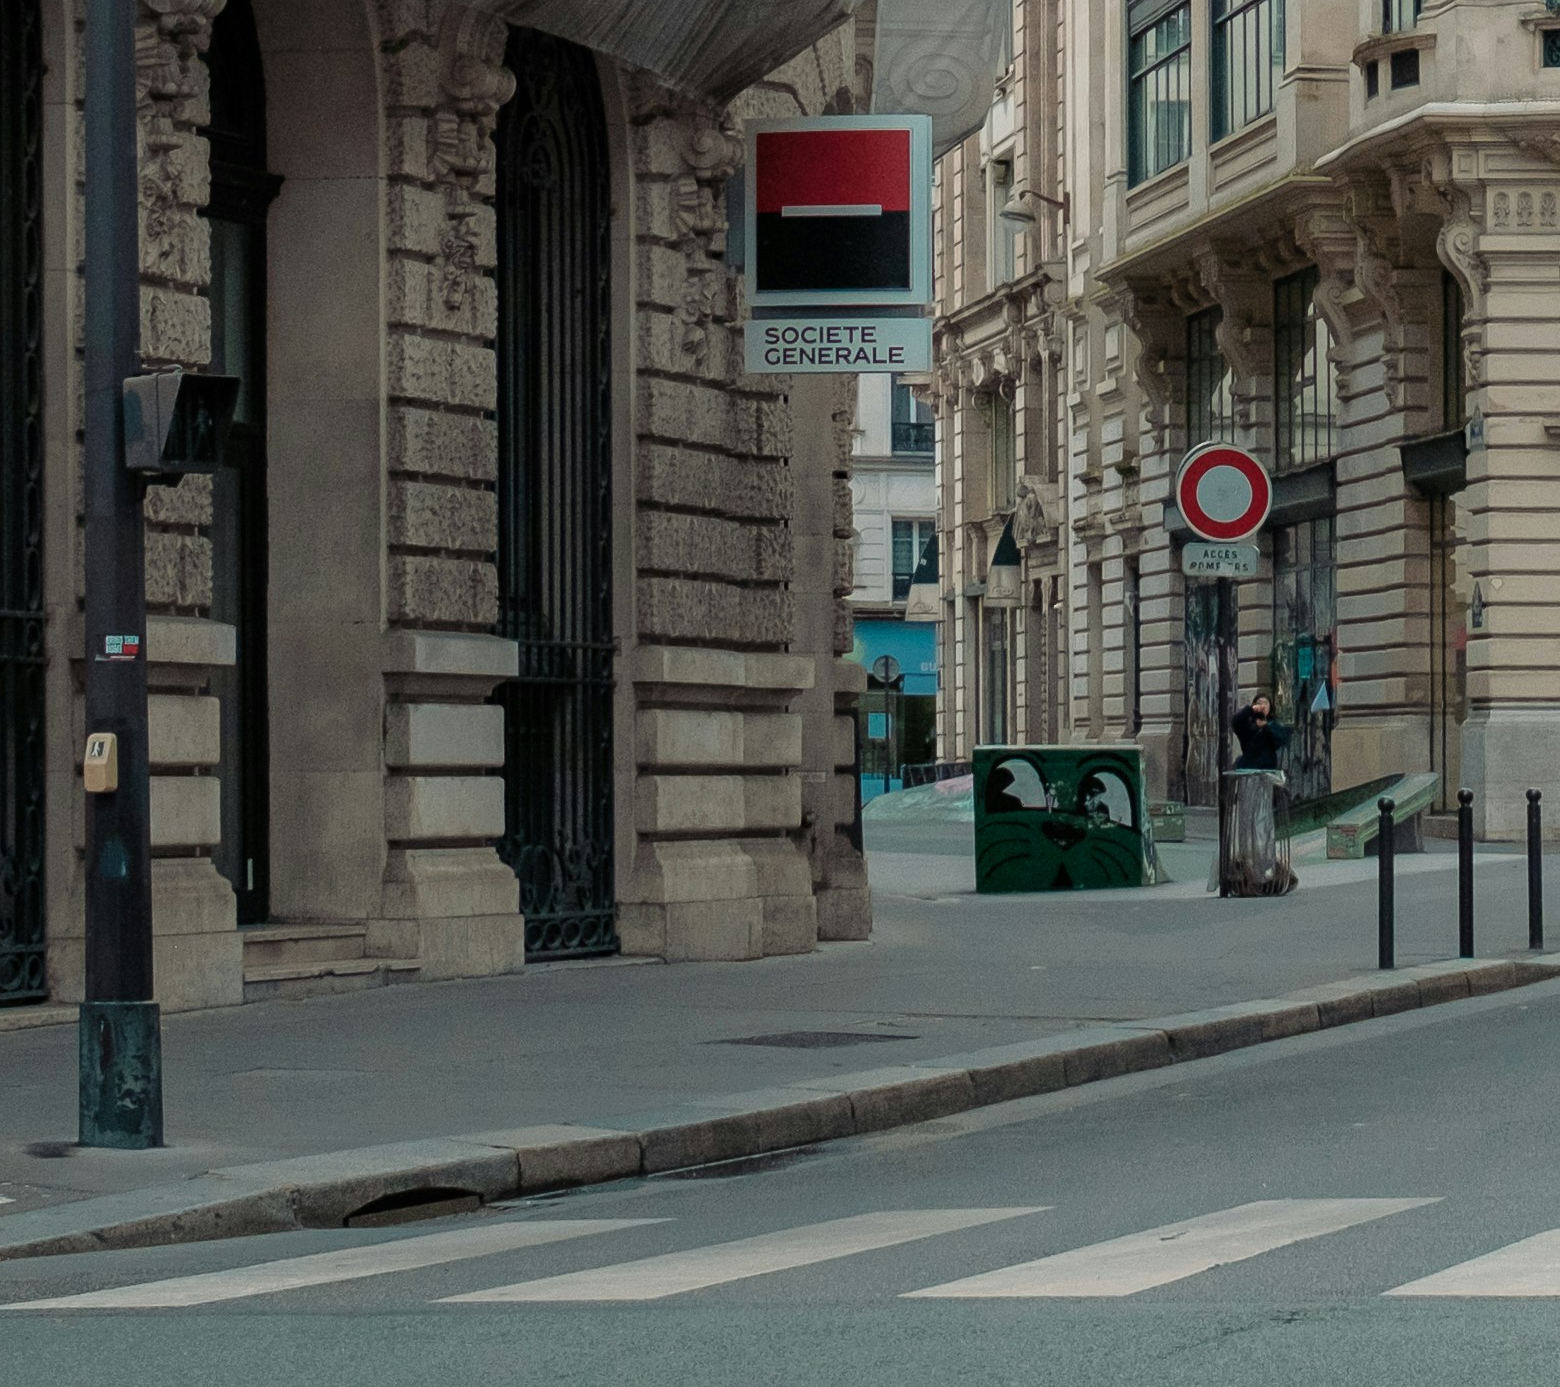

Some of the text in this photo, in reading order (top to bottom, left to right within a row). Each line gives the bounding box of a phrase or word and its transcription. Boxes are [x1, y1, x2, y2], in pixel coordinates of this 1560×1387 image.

[764, 326, 877, 345] SOCIETE
[764, 346, 905, 366] GENERALE
[1203, 549, 1238, 559] ACCÈS
